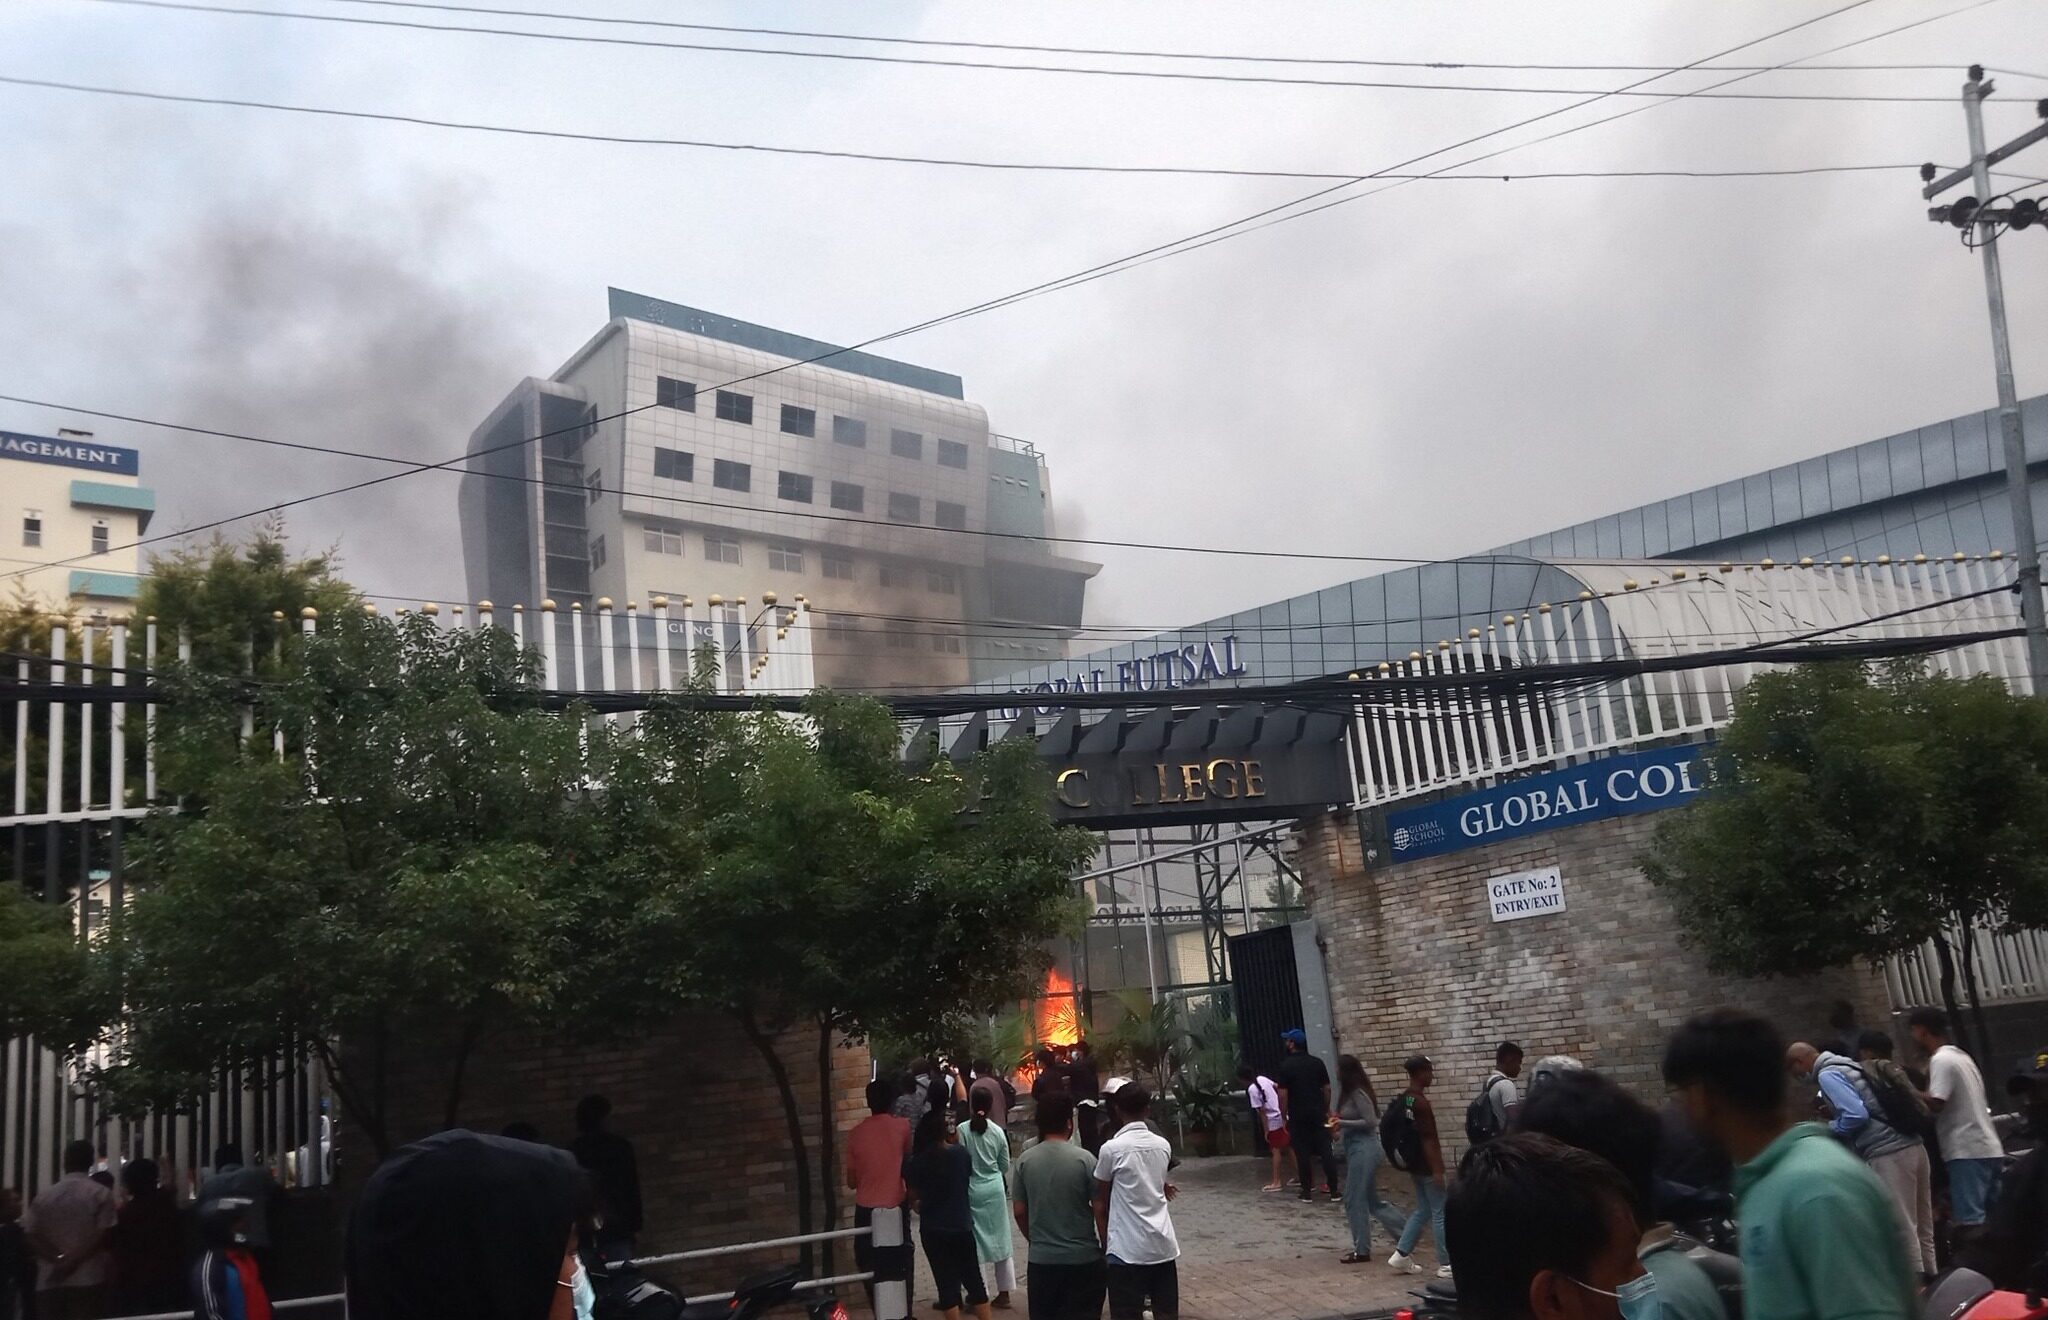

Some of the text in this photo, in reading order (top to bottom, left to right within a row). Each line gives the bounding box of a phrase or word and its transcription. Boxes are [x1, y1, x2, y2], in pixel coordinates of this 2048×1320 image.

[0, 437, 121, 465] AGEMENT
[1117, 635, 1247, 692] FUTSAL
[1056, 758, 1266, 808] CLLEGE
[1460, 779, 1599, 837] GLOBAL
[1410, 827, 1445, 843] SCHOOL
[1493, 875, 1557, 898] GATE No: 2
[1495, 894, 1560, 915] ENTRY/EXIT
